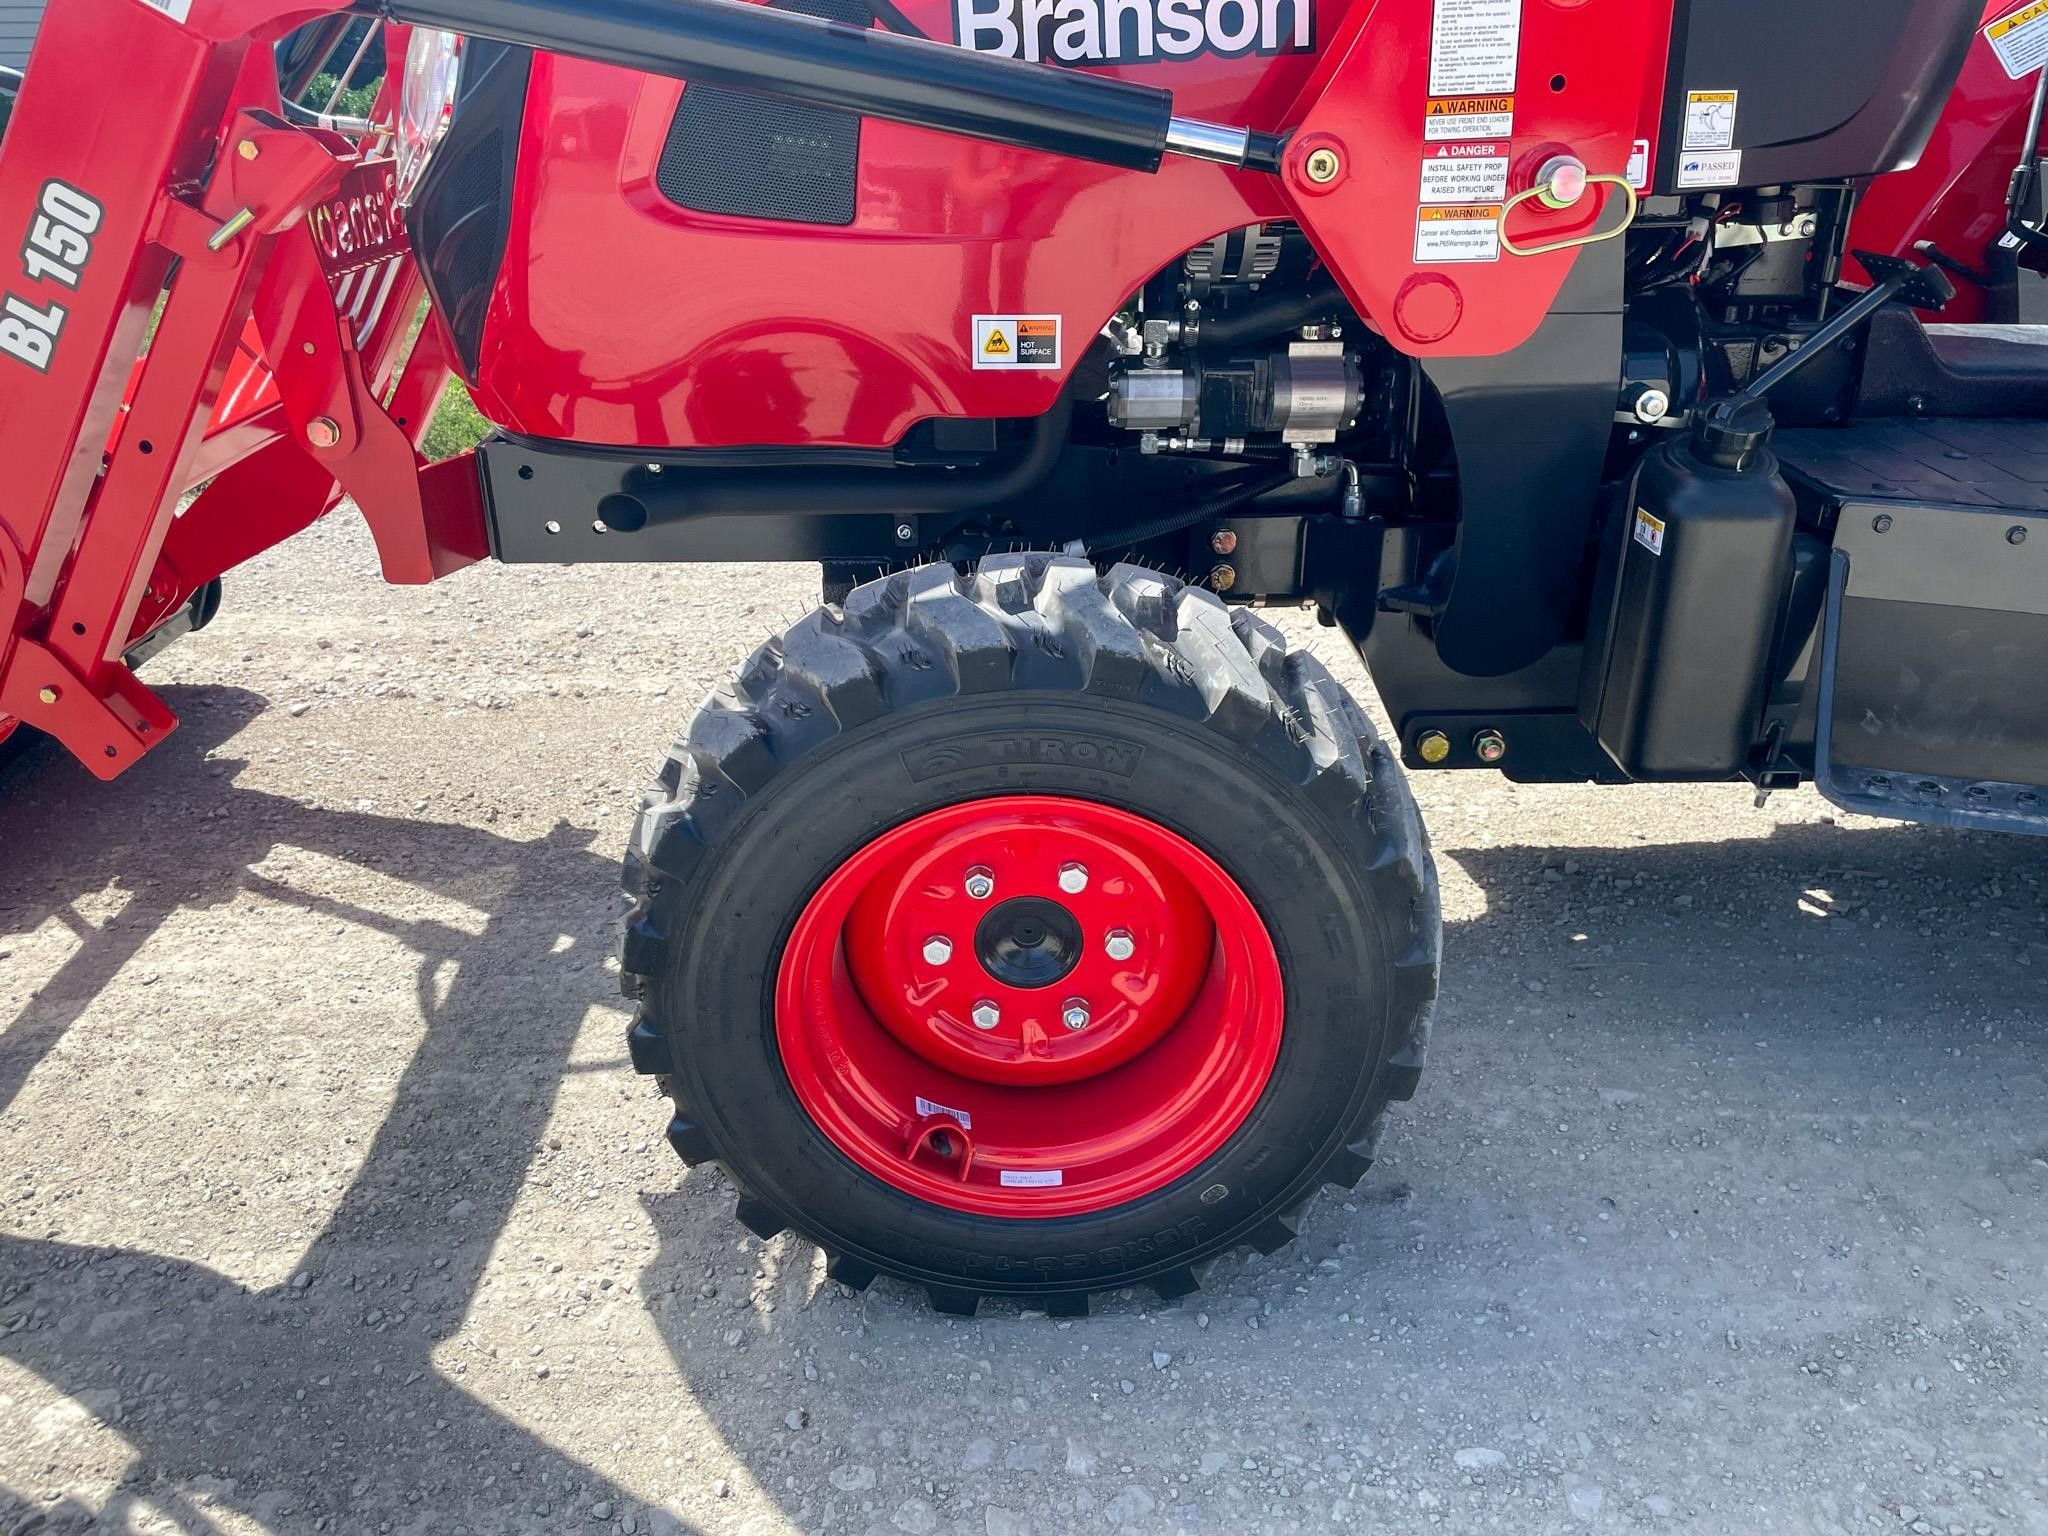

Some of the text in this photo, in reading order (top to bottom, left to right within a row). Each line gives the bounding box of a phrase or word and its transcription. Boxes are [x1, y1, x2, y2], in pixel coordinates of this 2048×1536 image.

[958, 0, 1310, 61] Branson
[1447, 99, 1508, 114] WARNING
[1429, 118, 1445, 126] NEVER
[1447, 117, 1457, 125] USE
[1477, 116, 1488, 124] END
[1489, 115, 1510, 123] LOADER
[1441, 126, 1460, 134] TOWING
[1451, 145, 1496, 156] DANGER
[1428, 163, 1503, 172] INSTALL SAFETY PROP
[1701, 161, 1735, 171] PASSED
[1423, 174, 1505, 183] BEFORE WORKING UNDER
[1431, 185, 1495, 194] RAISED STRUCTURE
[1444, 208, 1490, 219] WARNING
[1420, 229, 1438, 237] Cancer
[1450, 228, 1482, 237] Reproductive
[0, 182, 101, 369] BL 150
[1020, 341, 1035, 349] HOT
[1020, 348, 1052, 356] SURFACE
